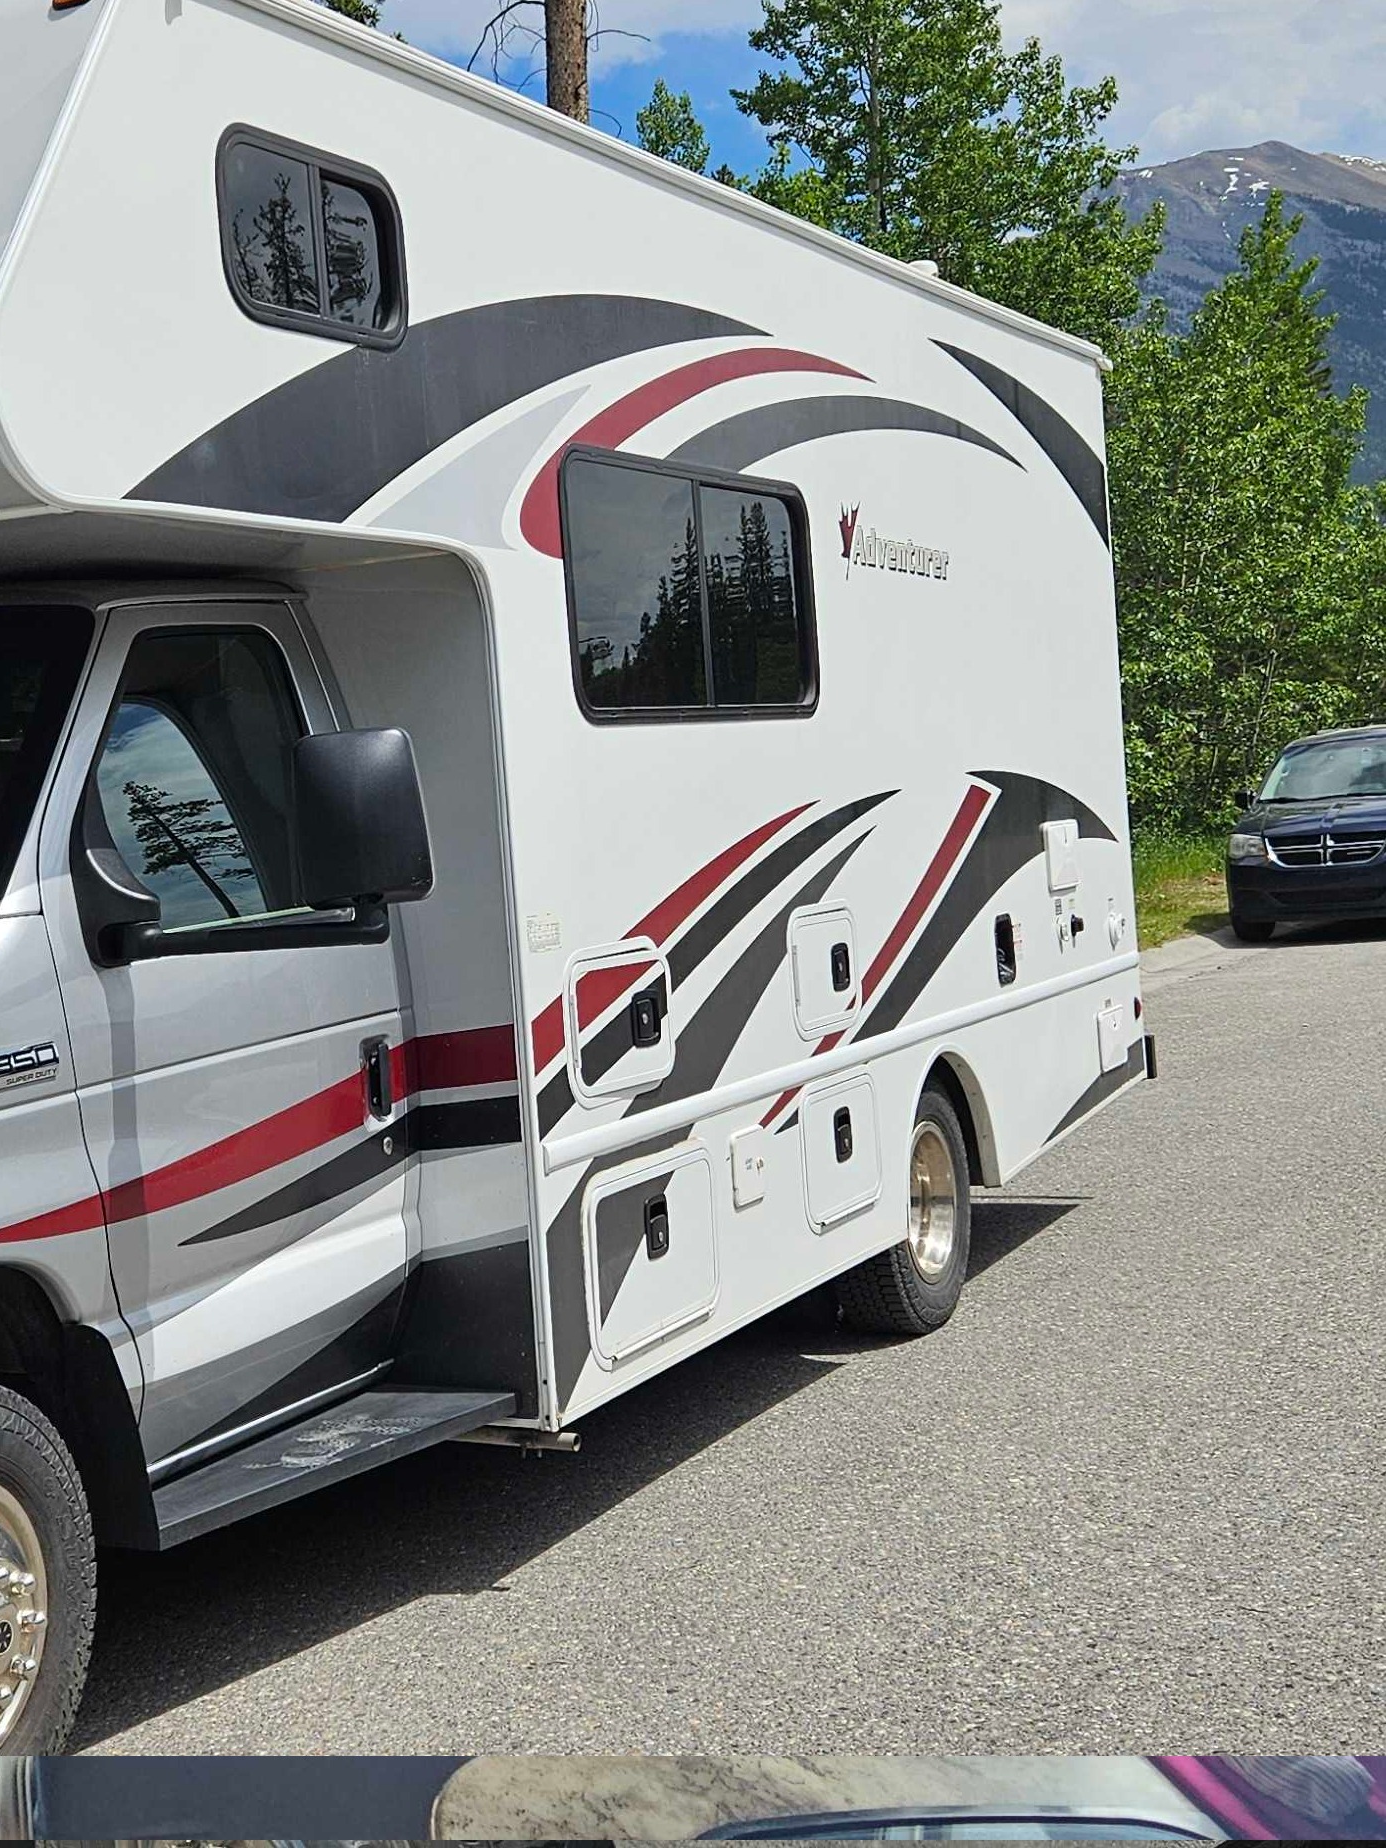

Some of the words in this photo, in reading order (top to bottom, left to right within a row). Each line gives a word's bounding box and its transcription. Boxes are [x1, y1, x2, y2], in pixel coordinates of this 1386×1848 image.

[852, 524, 949, 580] Adventurer
[5, 1072, 34, 1086] SUPER
[35, 1067, 58, 1079] DUTY
